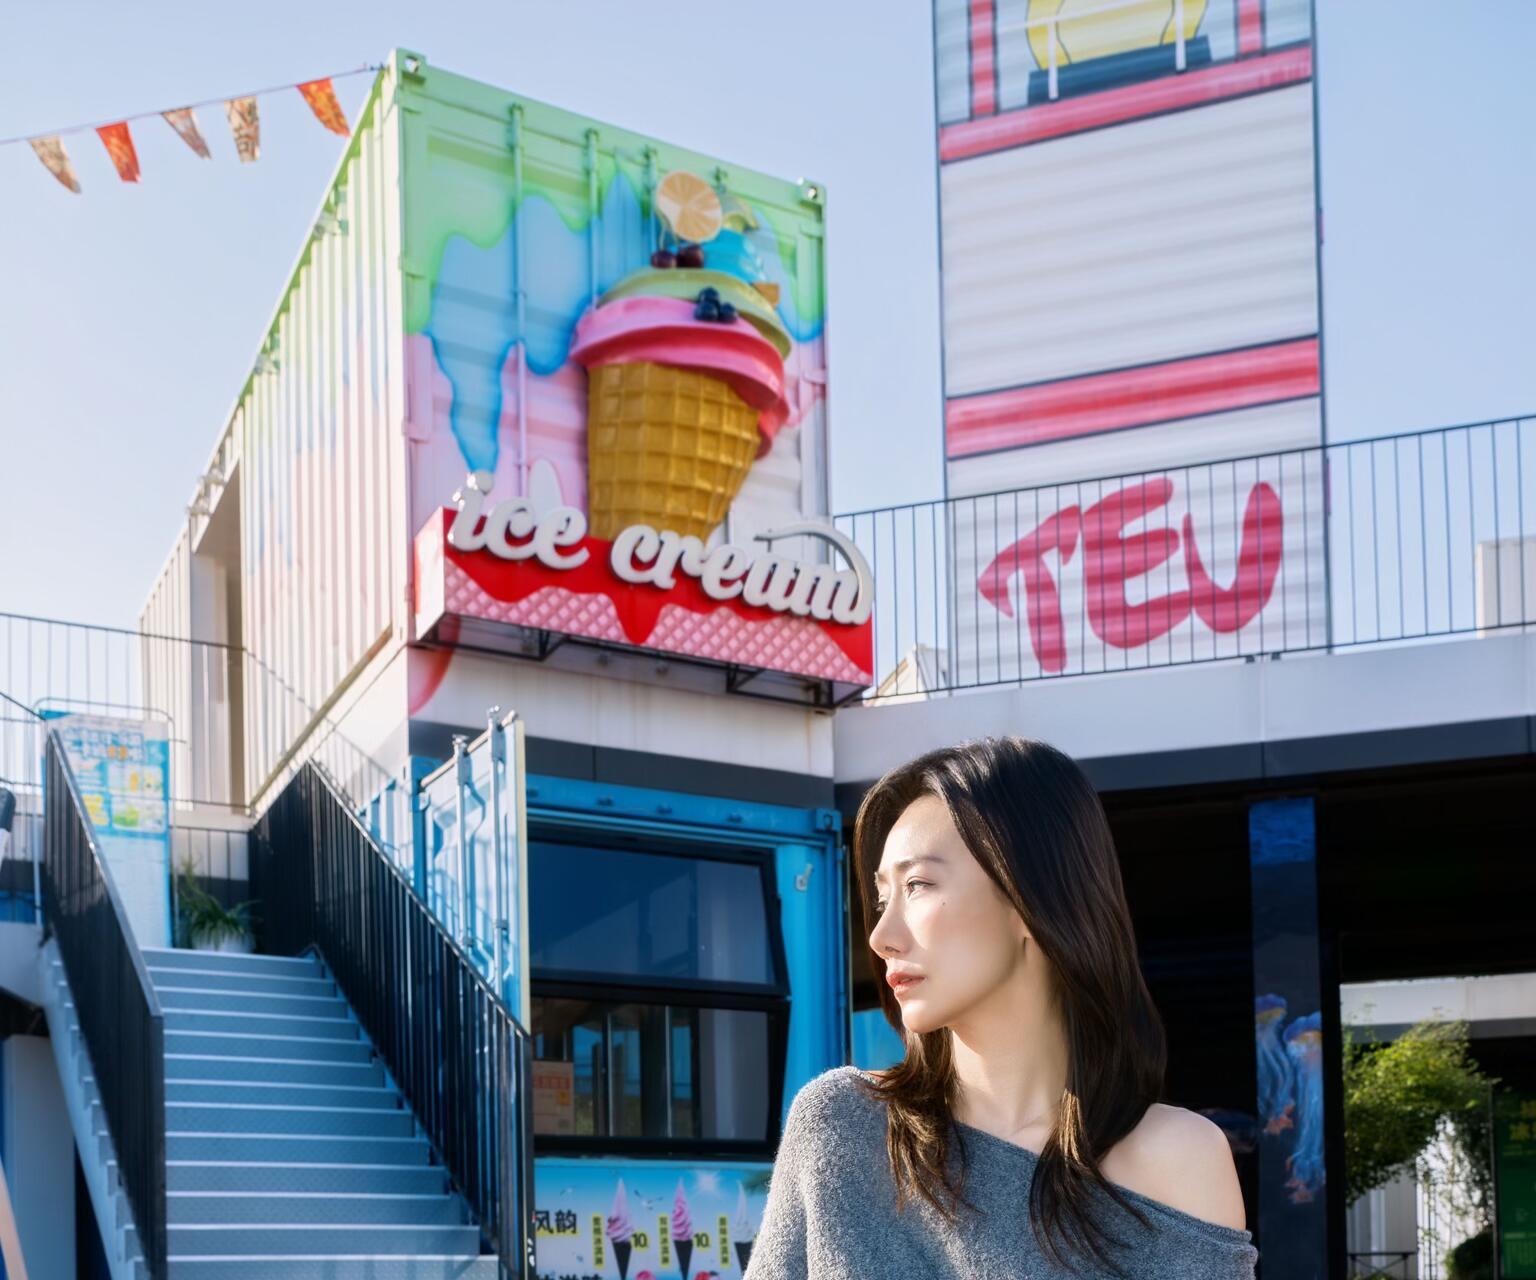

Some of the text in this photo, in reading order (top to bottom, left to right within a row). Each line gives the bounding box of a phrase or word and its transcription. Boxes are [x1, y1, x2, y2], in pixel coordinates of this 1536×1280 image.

[448, 472, 875, 626] ice cream
[977, 478, 1284, 673] TEU
